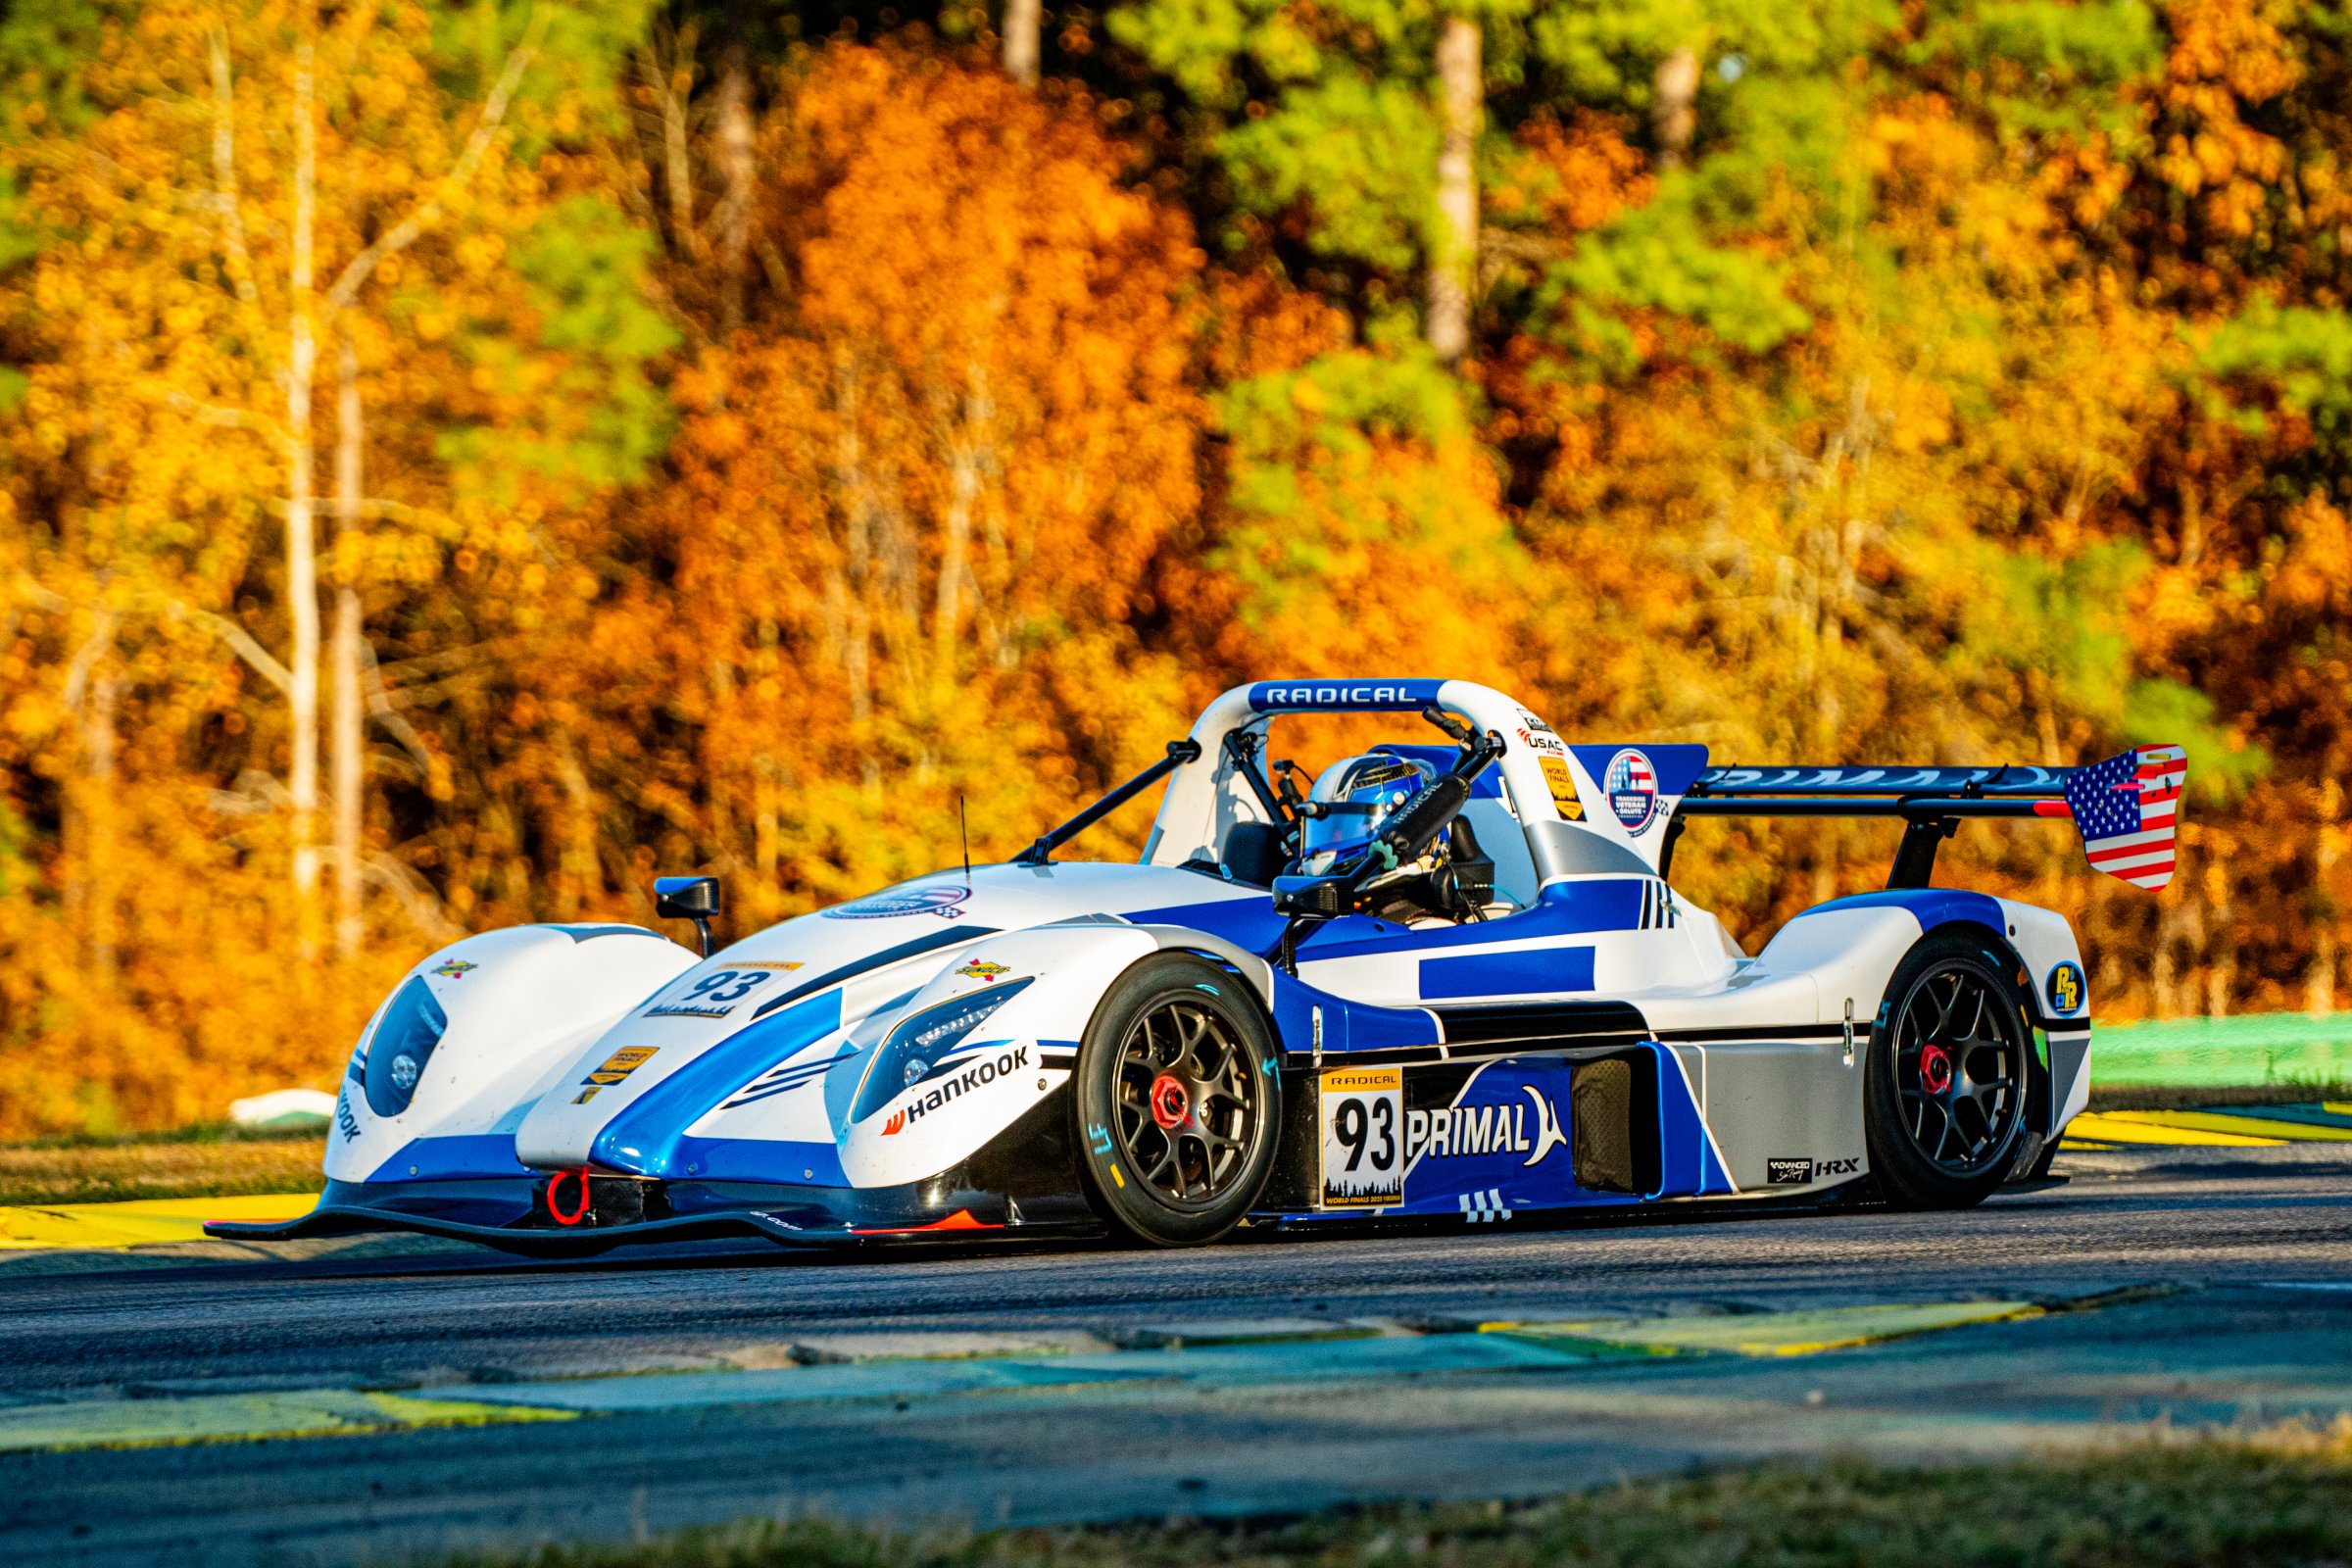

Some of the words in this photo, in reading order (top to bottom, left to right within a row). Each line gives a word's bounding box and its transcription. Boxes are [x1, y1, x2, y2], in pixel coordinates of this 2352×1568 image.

[1266, 687, 1417, 704] RADICAL
[1528, 737, 1563, 752] USAC
[1545, 767, 1568, 776] WORLD
[1549, 774, 1570, 784] FINALS
[1393, 781, 1444, 824] RADICAL
[680, 970, 772, 1003] 93
[1331, 1076, 1397, 1086] RADICAL
[1335, 1096, 1396, 1173] 93
[1406, 1102, 1531, 1158] PRIMAL
[1815, 1157, 1860, 1177] HRX
